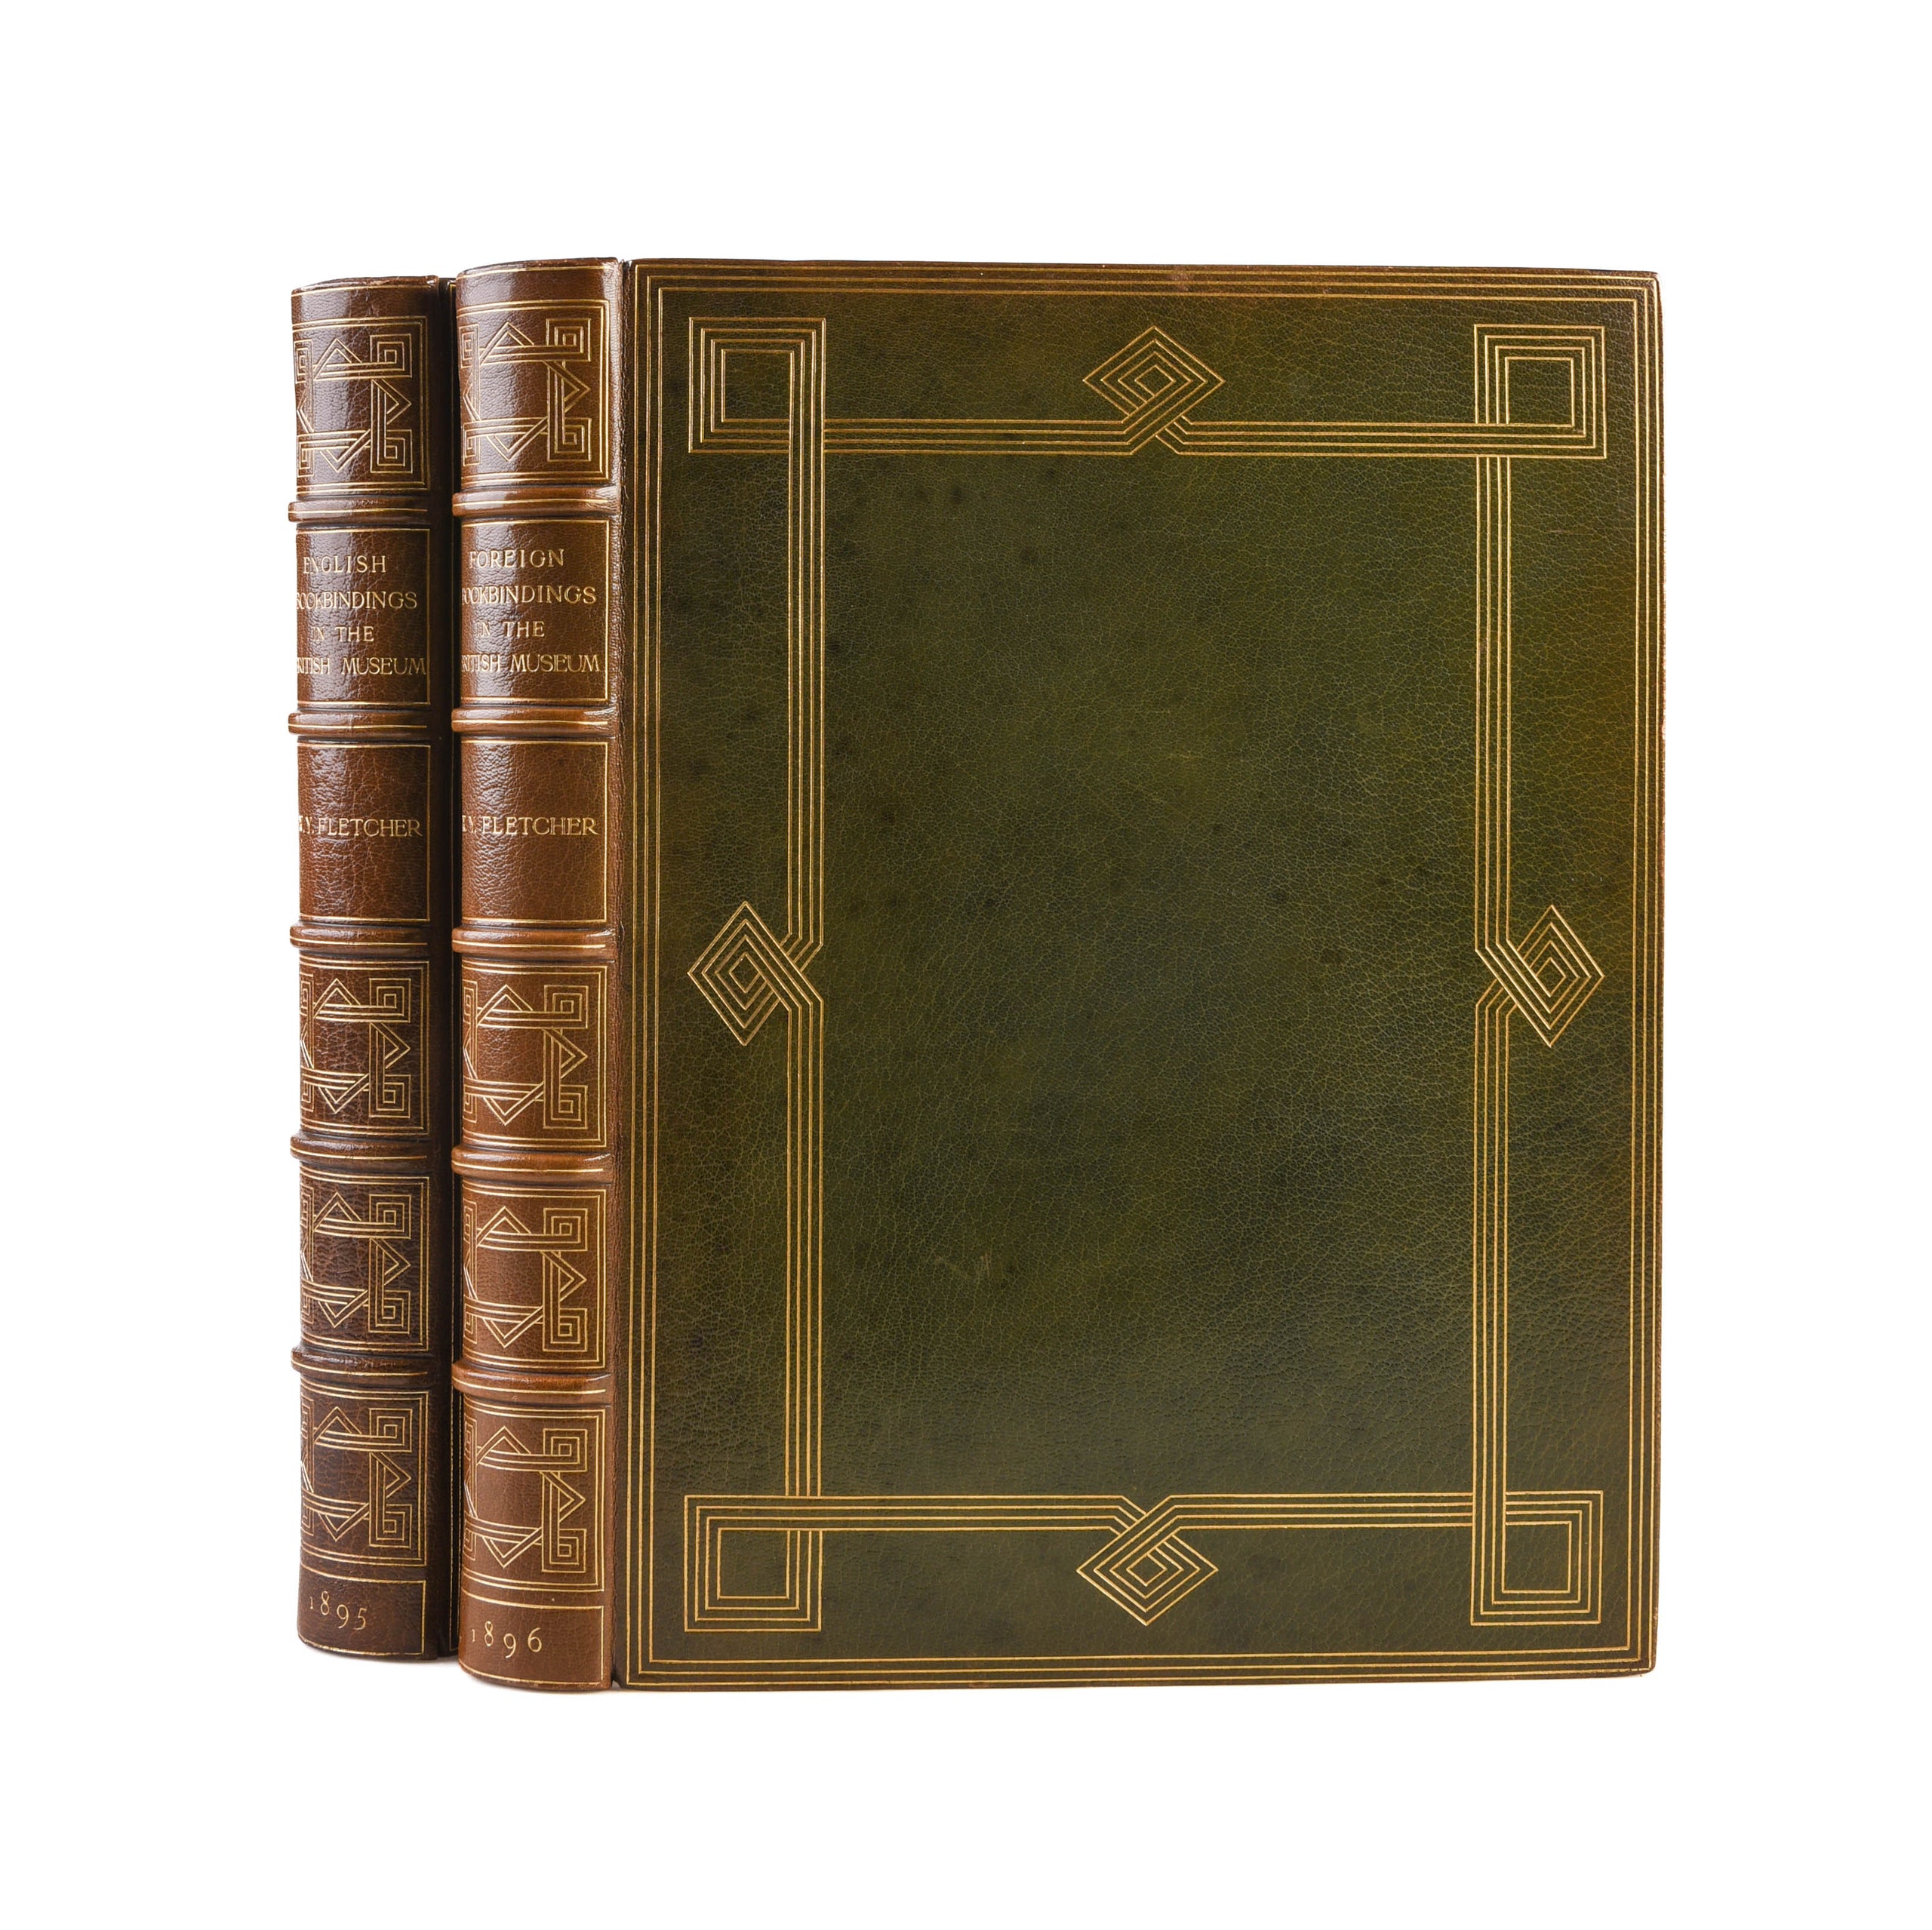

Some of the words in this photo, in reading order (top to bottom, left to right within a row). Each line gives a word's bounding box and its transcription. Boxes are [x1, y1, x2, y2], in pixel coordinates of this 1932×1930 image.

[303, 555, 386, 573] ENGLISH
[469, 549, 565, 568] FOREIGN
[312, 626, 325, 642] IN
[334, 625, 374, 642] THE
[475, 622, 491, 638] IN
[503, 621, 546, 638] THE
[297, 656, 331, 675] RITISH
[340, 657, 427, 675] MUSEUM
[462, 654, 501, 672] RITISH
[510, 654, 601, 673] MUSEUM
[318, 817, 423, 837] FLETCHER
[481, 816, 598, 836] FLETCHER
[309, 1590, 368, 1630] 1895
[471, 1621, 543, 1659] 1896
